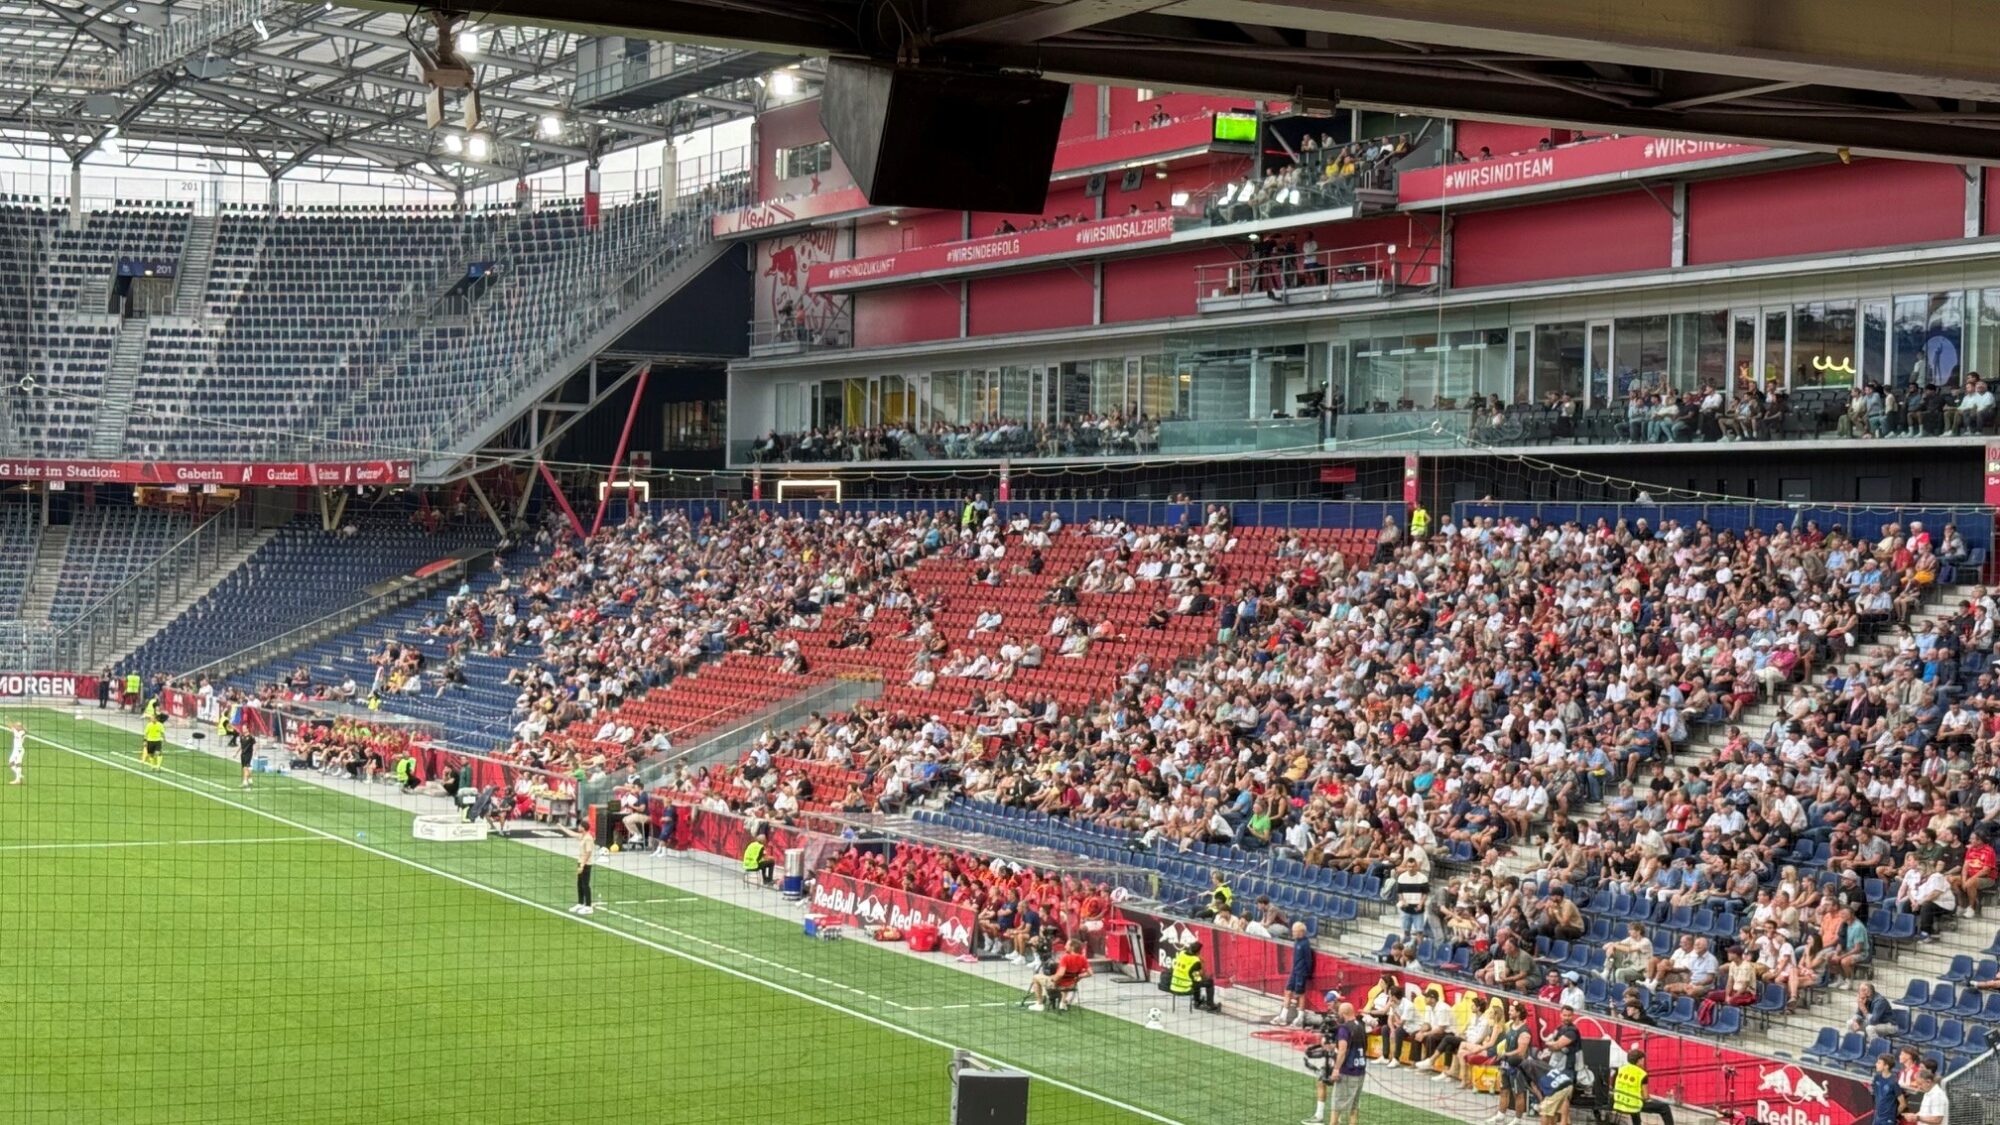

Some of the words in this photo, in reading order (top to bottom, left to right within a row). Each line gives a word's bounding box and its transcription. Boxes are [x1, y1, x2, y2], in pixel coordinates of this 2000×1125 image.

[1445, 157, 1554, 189] #WIRSINDTEAM
[181, 182, 198, 191] 201
[1076, 216, 1175, 243] #WIRSINDSALZBURG
[946, 240, 1020, 262] #WIRSINDERFOLG
[156, 265, 172, 274] 201
[828, 258, 896, 279] #WIRSINDZUKUNFT
[14, 464, 41, 476] hier
[45, 465, 63, 477] im
[66, 466, 121, 479] Stadion:
[814, 884, 836, 909] Red
[833, 889, 855, 914] Bull
[890, 905, 914, 931] Red
[1757, 1099, 1794, 1125] Red
